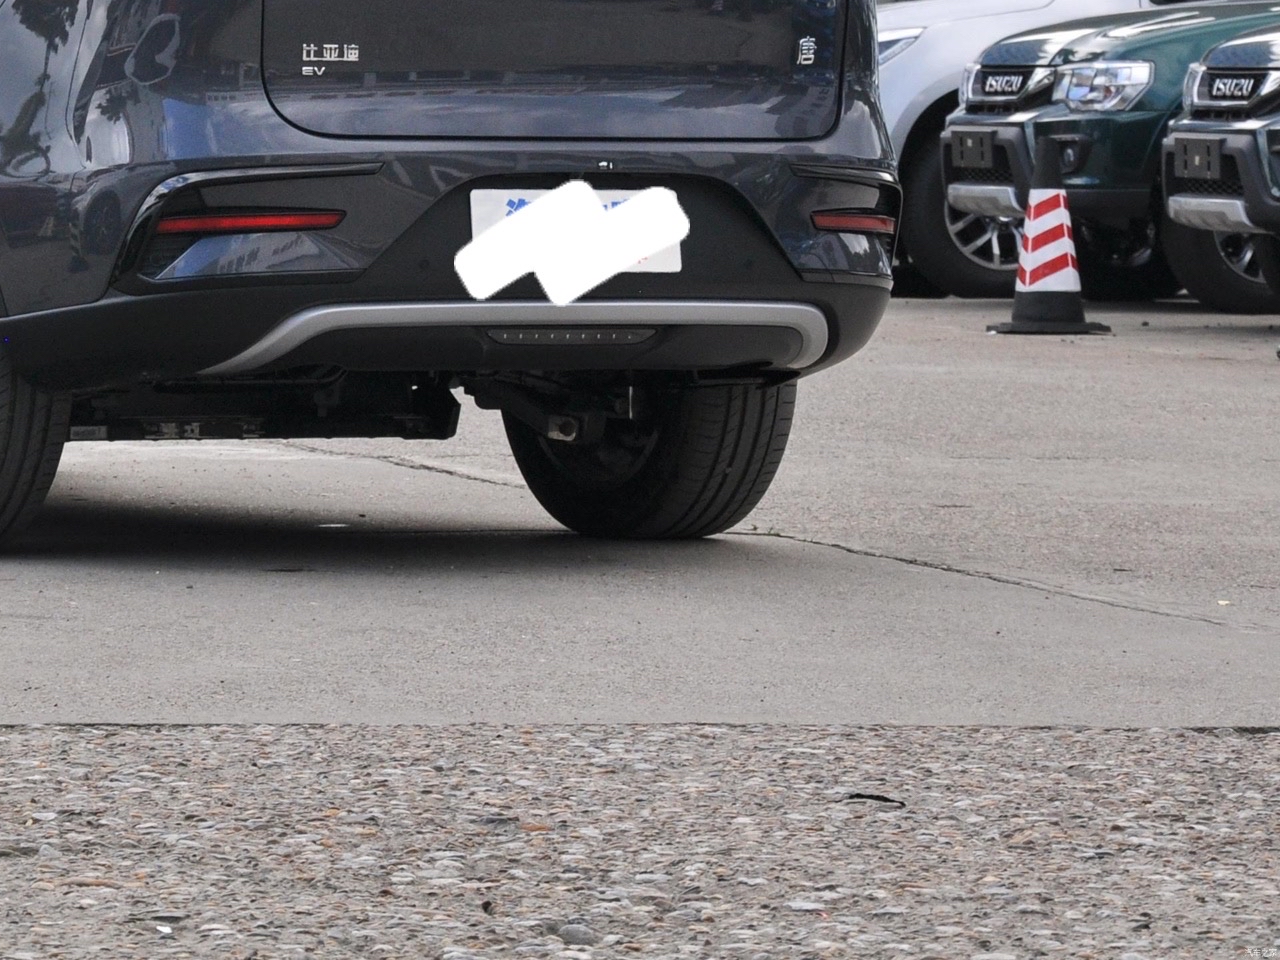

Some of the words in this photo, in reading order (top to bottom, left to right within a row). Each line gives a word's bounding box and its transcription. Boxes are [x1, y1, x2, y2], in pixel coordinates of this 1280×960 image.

[302, 43, 359, 61] 比亚迪
[796, 35, 817, 65] 唐
[302, 66, 326, 76] EV
[985, 75, 1023, 93] ISUZU
[1212, 78, 1255, 97] ISUZU
